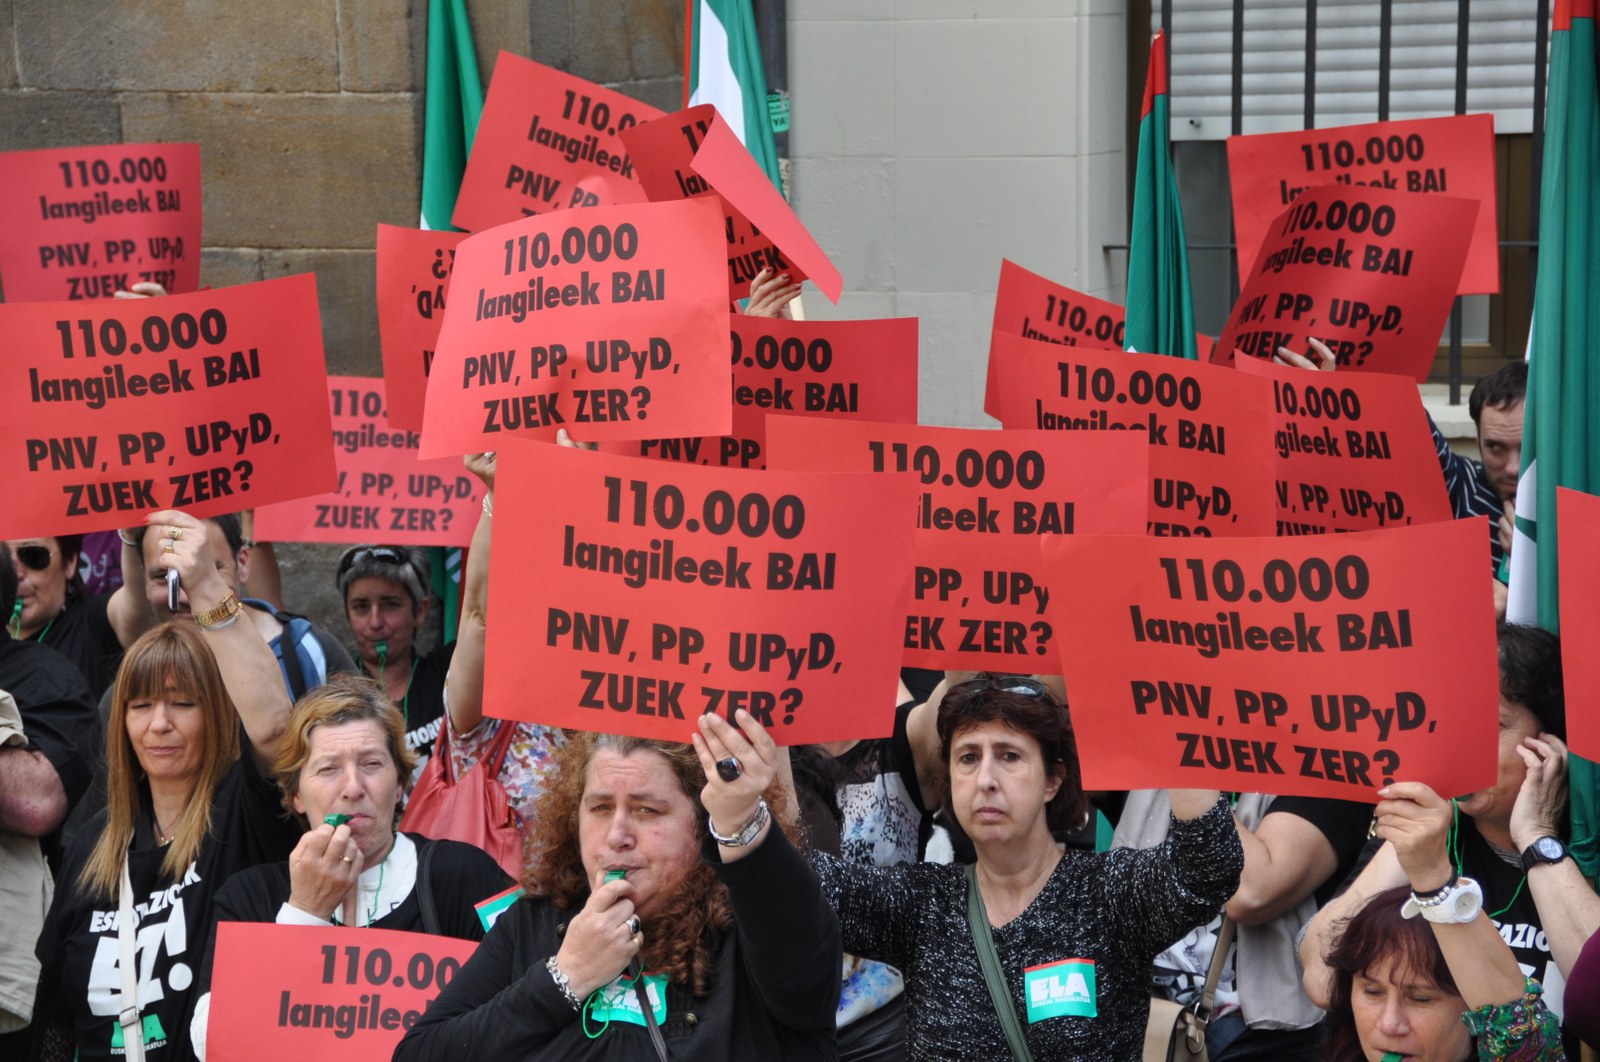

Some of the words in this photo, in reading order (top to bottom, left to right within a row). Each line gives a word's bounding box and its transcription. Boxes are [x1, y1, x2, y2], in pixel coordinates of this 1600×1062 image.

[527, 115, 633, 179] langileek
[1302, 134, 1423, 172] 110.000
[59, 157, 166, 188] 110.000
[505, 164, 561, 209] PNV,
[568, 187, 600, 208] PP
[1407, 168, 1447, 193] BAI
[40, 195, 151, 222] langileek
[156, 190, 181, 212] BAI
[1282, 201, 1395, 237] 110.000
[38, 243, 97, 268] PNV,
[104, 239, 143, 264] PP,
[504, 223, 638, 275] 110.000
[1362, 245, 1413, 276] BAI
[67, 274, 131, 300] ZUEK
[476, 272, 600, 323] langileek
[612, 269, 665, 302] BAI
[56, 308, 227, 358] 110.000
[1045, 294, 1124, 347] 110.00
[1275, 293, 1316, 327] PP,
[1329, 298, 1404, 336] UPyD,
[28, 358, 194, 410] langileek
[203, 348, 261, 388] BAI
[463, 350, 520, 389] PNV,
[530, 343, 577, 378] PP,
[586, 337, 681, 379] UPyD,
[483, 391, 565, 433] ZUEK
[574, 386, 652, 424] ZER?
[805, 382, 858, 412] BAI
[1058, 362, 1202, 412] 110.000
[26, 436, 108, 472] PNV,
[118, 431, 175, 466] PP,
[185, 412, 280, 456] UPyD,
[1178, 419, 1225, 455] BAI
[1345, 431, 1391, 459] BAI
[361, 473, 398, 499] PP,
[408, 475, 477, 503] UPyD,
[869, 441, 1045, 490] 110.000
[63, 479, 160, 517] ZUEK
[169, 460, 254, 508] ZER?
[604, 476, 805, 539] 110.000
[1153, 478, 1237, 522] UPyD,
[1299, 484, 1336, 518] PP,
[1340, 488, 1411, 526] UPyD,
[314, 505, 380, 529] ZUEK
[390, 507, 453, 531] ZER?
[1013, 501, 1075, 535] BAI
[563, 526, 751, 588] langileek
[766, 553, 837, 591] BAI
[1160, 556, 1369, 602] 110.000
[914, 566, 969, 608] PP,
[546, 608, 636, 662] PNV,
[651, 624, 712, 673] PP,
[728, 633, 842, 680] UPyD,
[958, 618, 1053, 656] ZER?
[1129, 606, 1325, 658] langileek
[1337, 610, 1412, 651] BAI
[578, 671, 686, 720] ZUEK
[701, 687, 803, 729] ZER?
[1130, 681, 1224, 726] PNV,
[1234, 690, 1298, 734] PP,
[1310, 692, 1437, 741] UPyD,
[1176, 733, 1285, 774] ZUEK
[1294, 745, 1400, 787] ZER?
[321, 945, 460, 990] 110.00
[1030, 973, 1090, 1003] ELA
